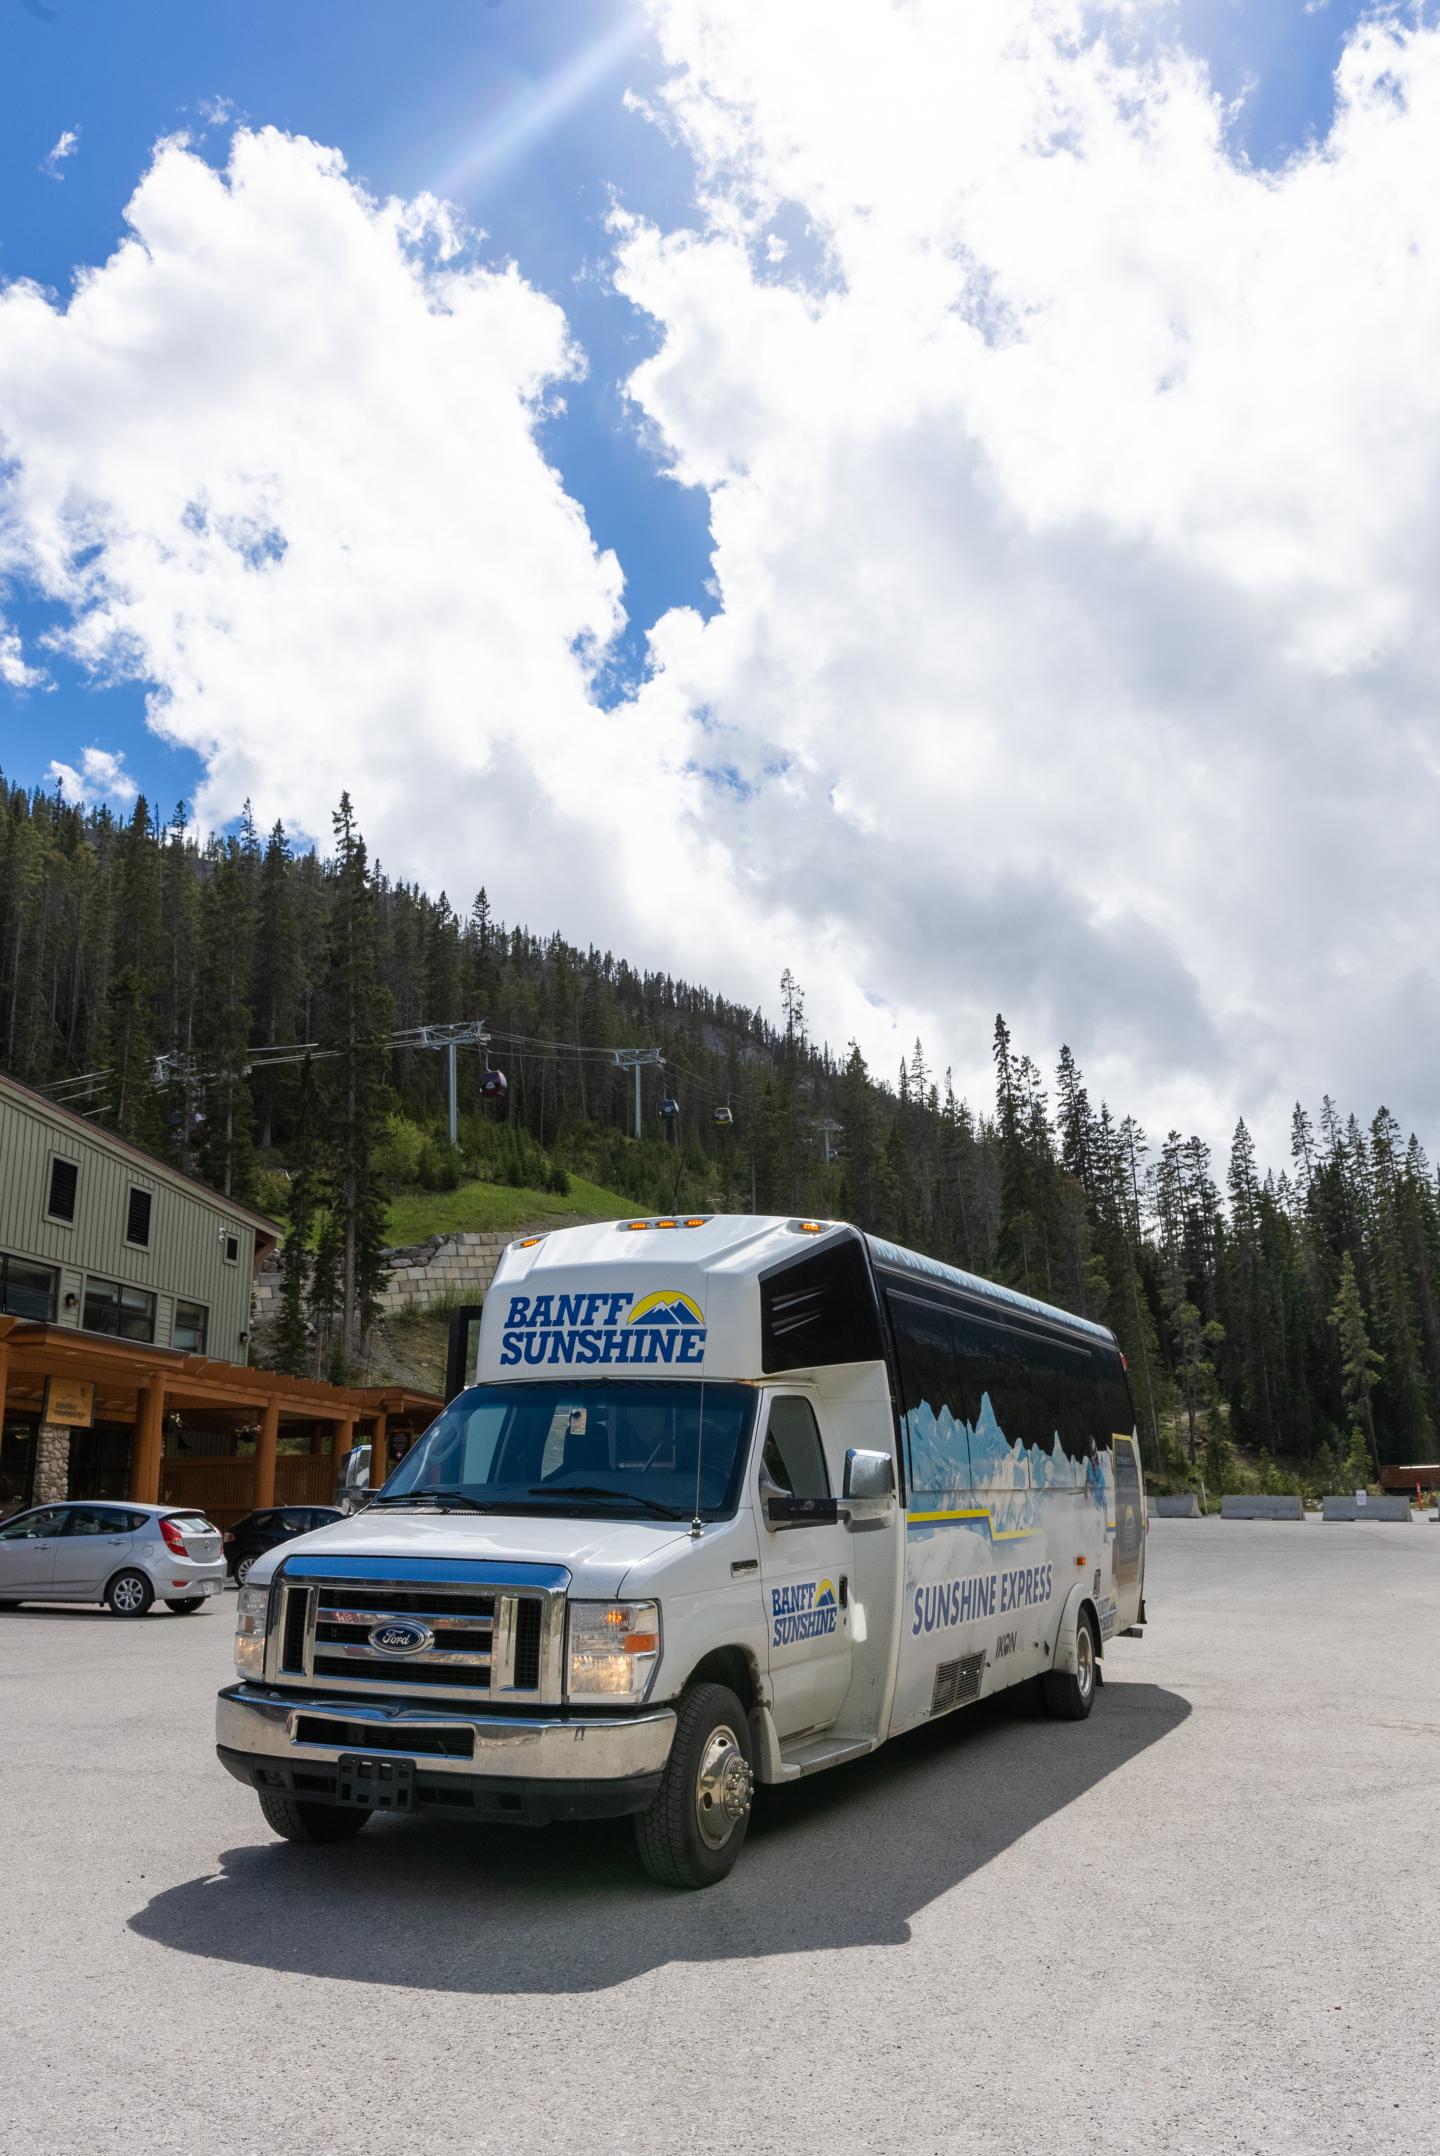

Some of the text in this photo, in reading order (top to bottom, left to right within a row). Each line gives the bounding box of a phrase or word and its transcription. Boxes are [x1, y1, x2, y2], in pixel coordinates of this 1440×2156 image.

[504, 1292, 634, 1329] BANFF
[500, 1328, 708, 1366] SUNSHINE
[771, 1582, 817, 1617] BANFF
[912, 1563, 1053, 1636] SUNSHINE EXPRESS
[382, 1628, 411, 1645] Ford
[772, 1606, 838, 1648] SUNSHINE
[995, 1630, 1018, 1659] IKON
